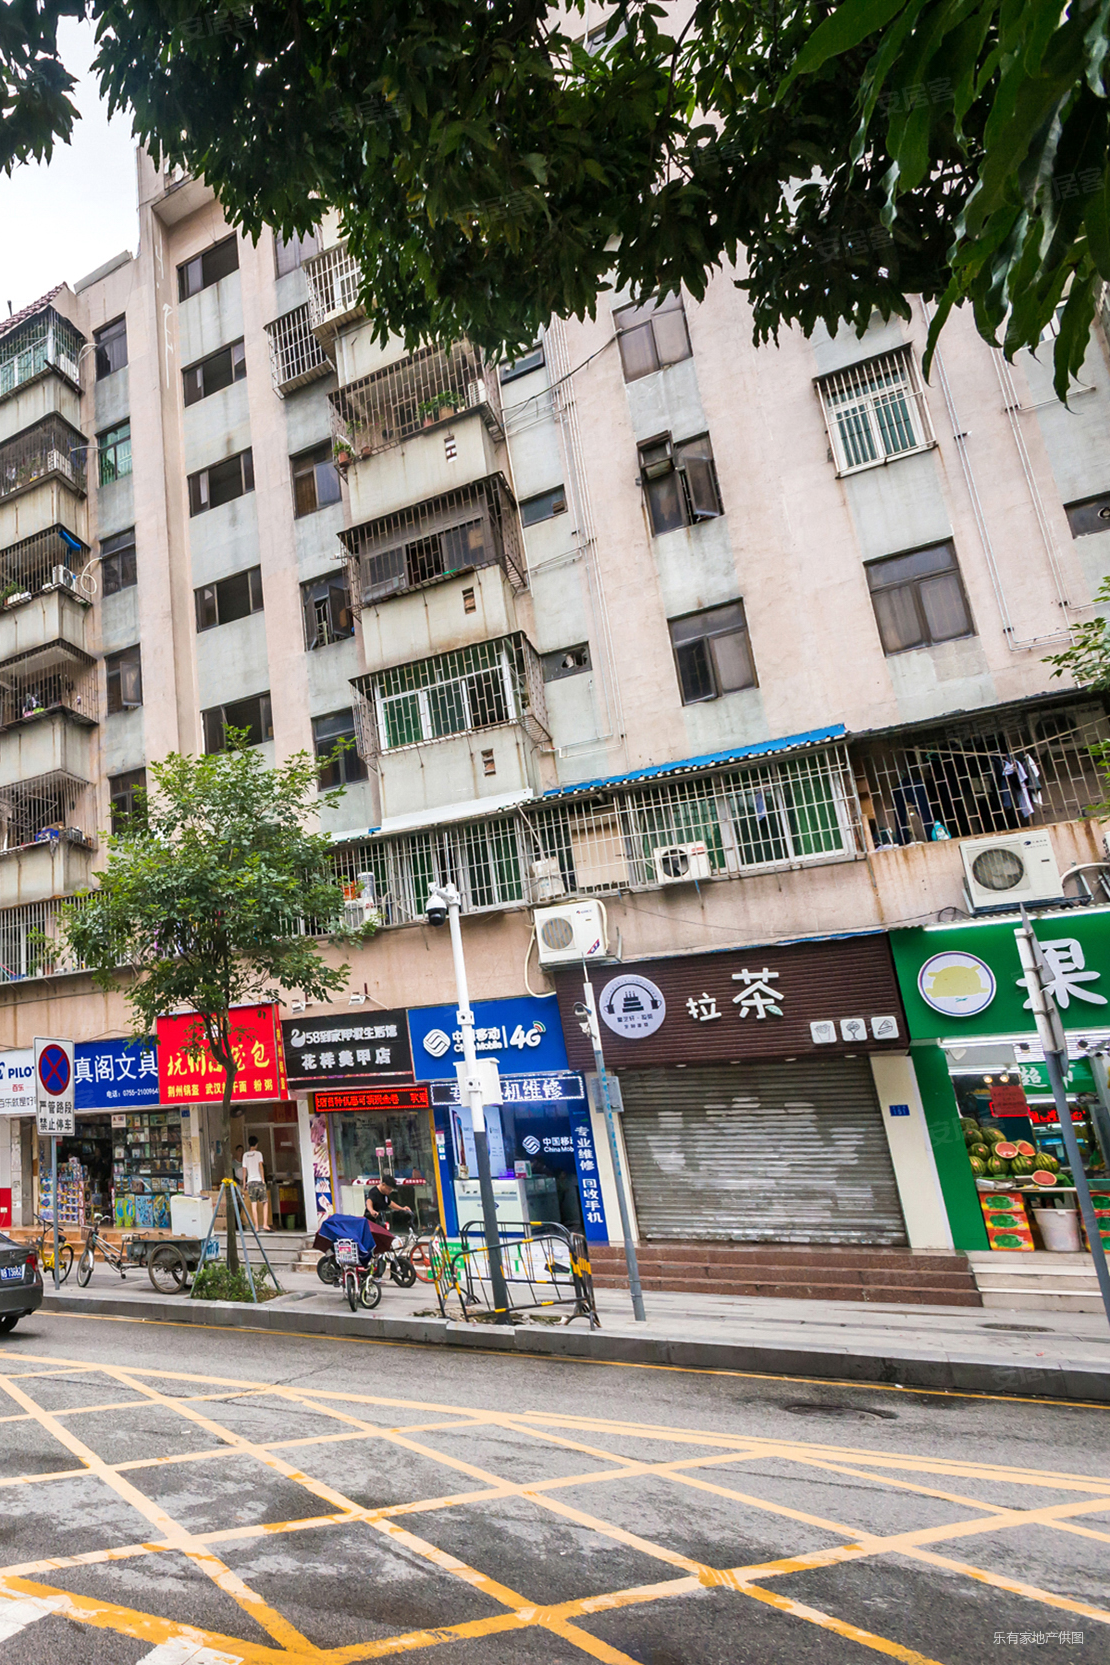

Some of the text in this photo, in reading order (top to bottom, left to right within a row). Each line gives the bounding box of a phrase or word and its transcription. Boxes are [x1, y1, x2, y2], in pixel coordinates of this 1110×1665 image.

[1016, 937, 1108, 1010] 果
[686, 967, 784, 1022] 拉茶
[452, 1027, 501, 1044] 中移动
[509, 1024, 542, 1050] 4G
[74, 1051, 158, 1084] 真阁文具
[39, 1100, 72, 1114] 严管路段
[39, 1117, 72, 1131] 禁止停车
[574, 1126, 595, 1171] 专业维修
[582, 1178, 604, 1223] 回收手机
